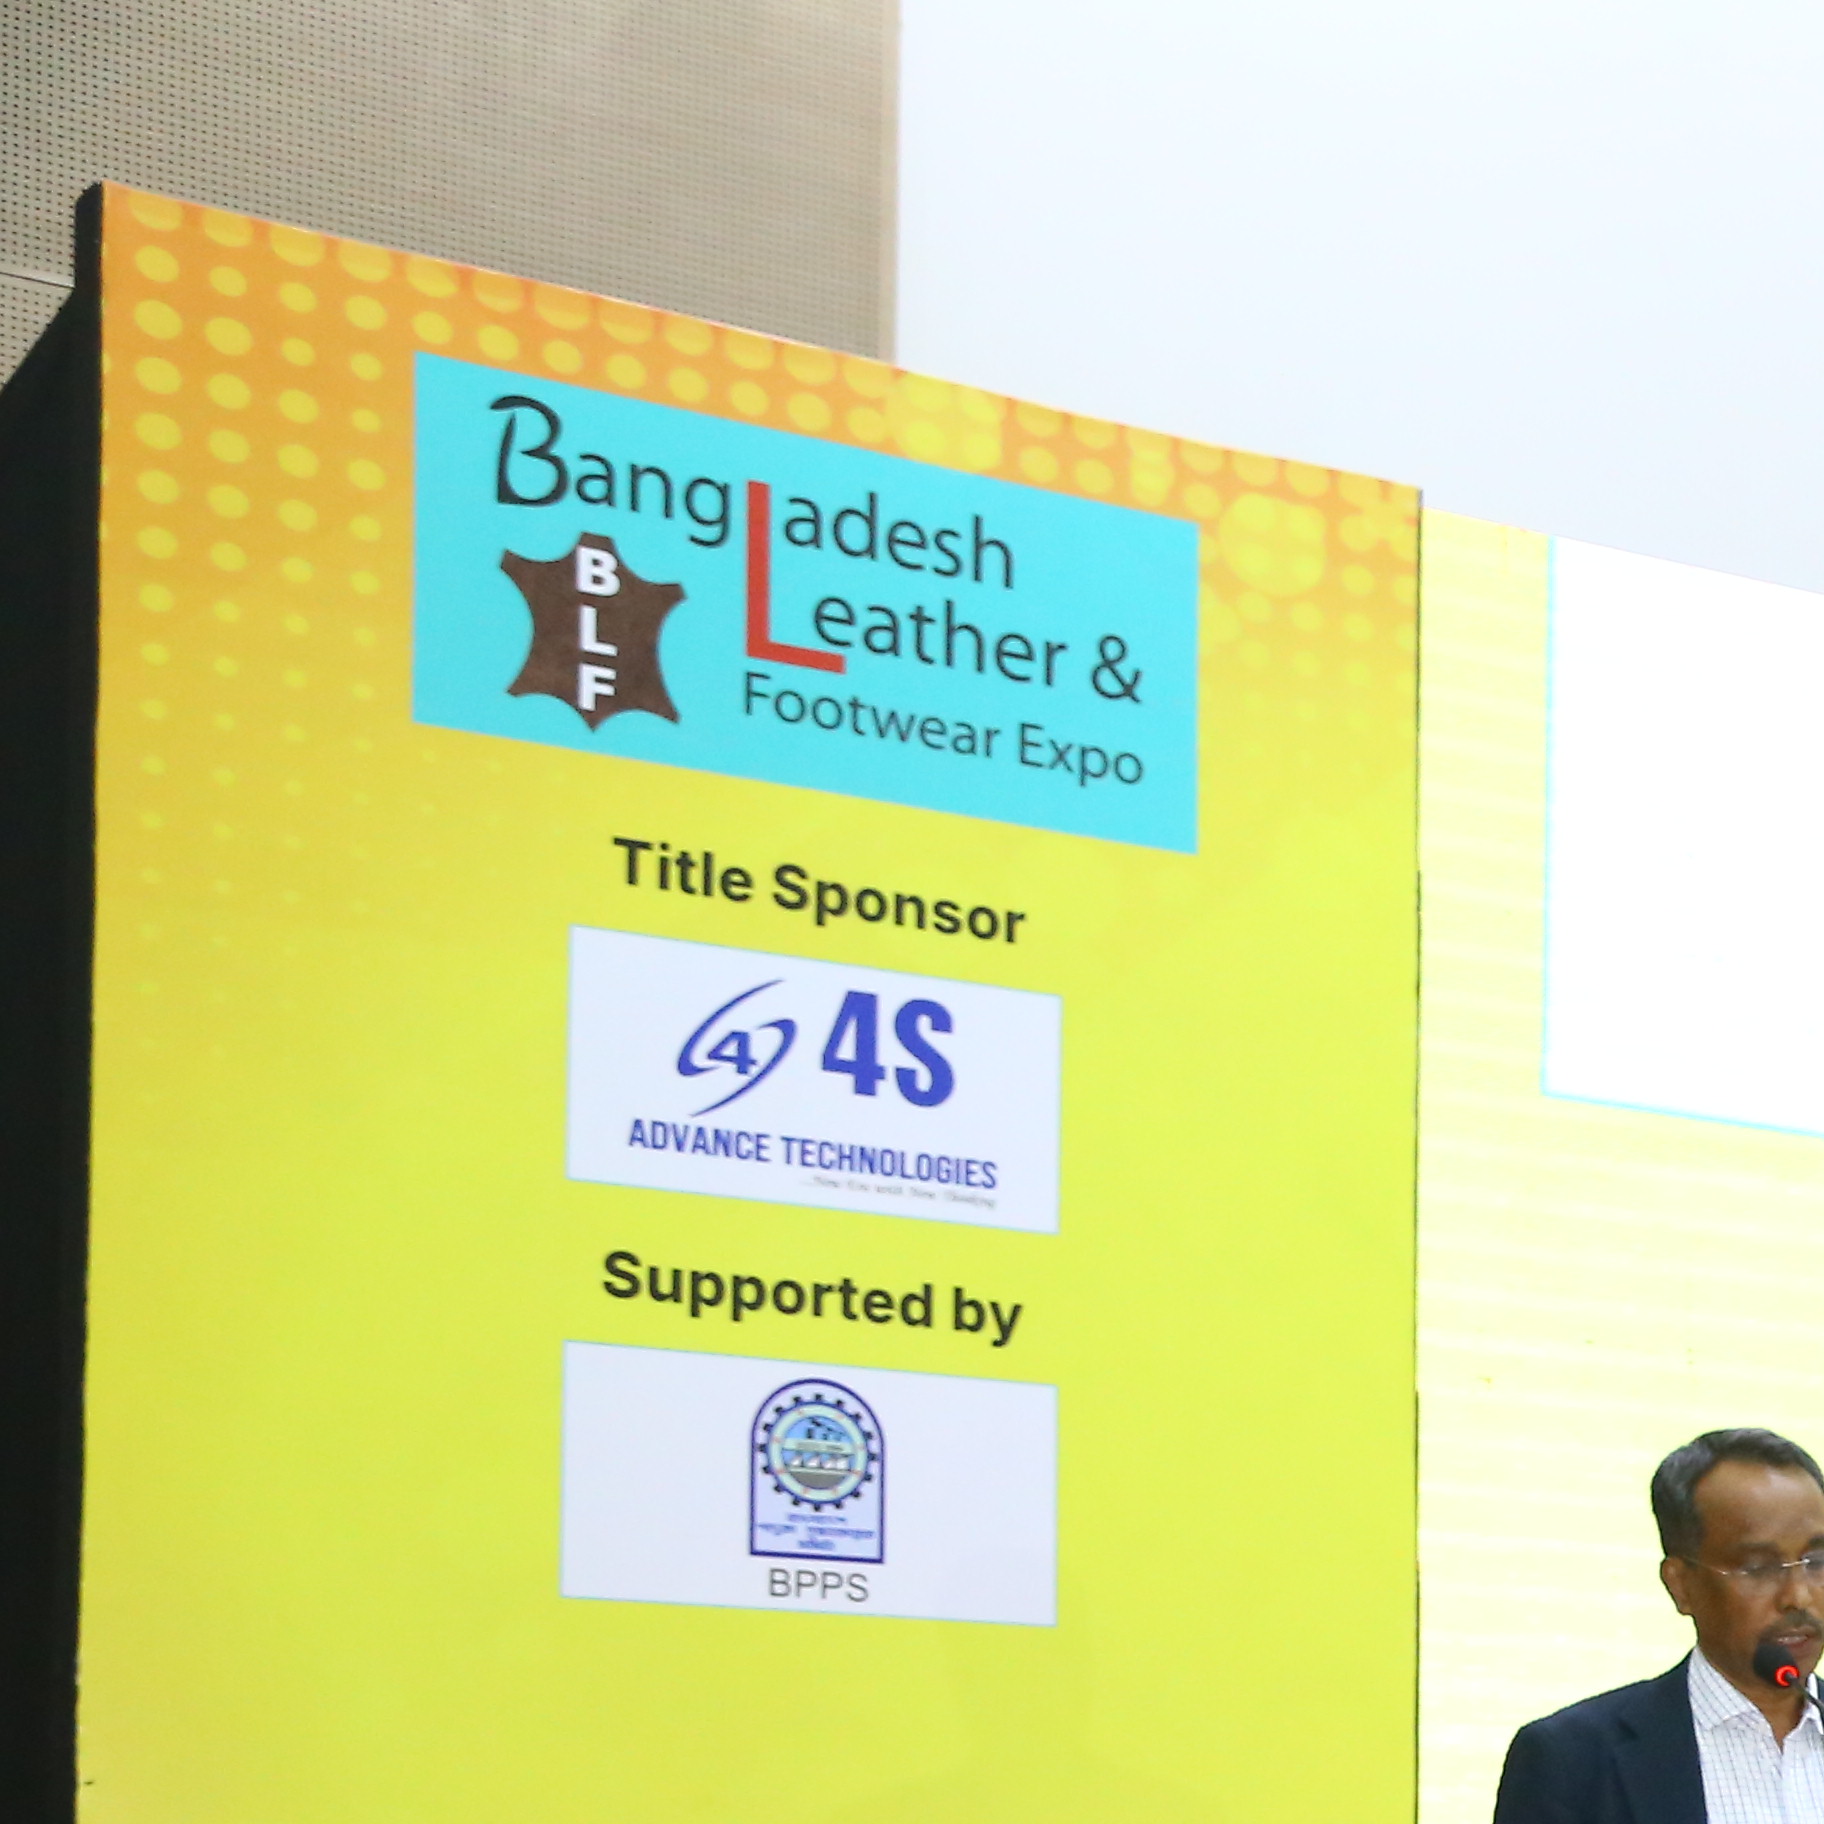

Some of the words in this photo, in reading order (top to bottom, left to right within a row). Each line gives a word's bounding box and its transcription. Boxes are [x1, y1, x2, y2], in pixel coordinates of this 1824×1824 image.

[1092, 635, 1144, 704] &
[743, 672, 999, 758] Footwear
[1018, 724, 1144, 789] Expo
[613, 836, 754, 902] Title
[773, 864, 1027, 944] Sponsor
[821, 990, 956, 1108] 4S
[628, 1119, 770, 1163] ADVANCE
[780, 1136, 998, 1190] TECHNOLOGIES
[603, 1250, 933, 1327] Supported
[953, 1288, 1023, 1348] by
[768, 1567, 869, 1602] BPPS
